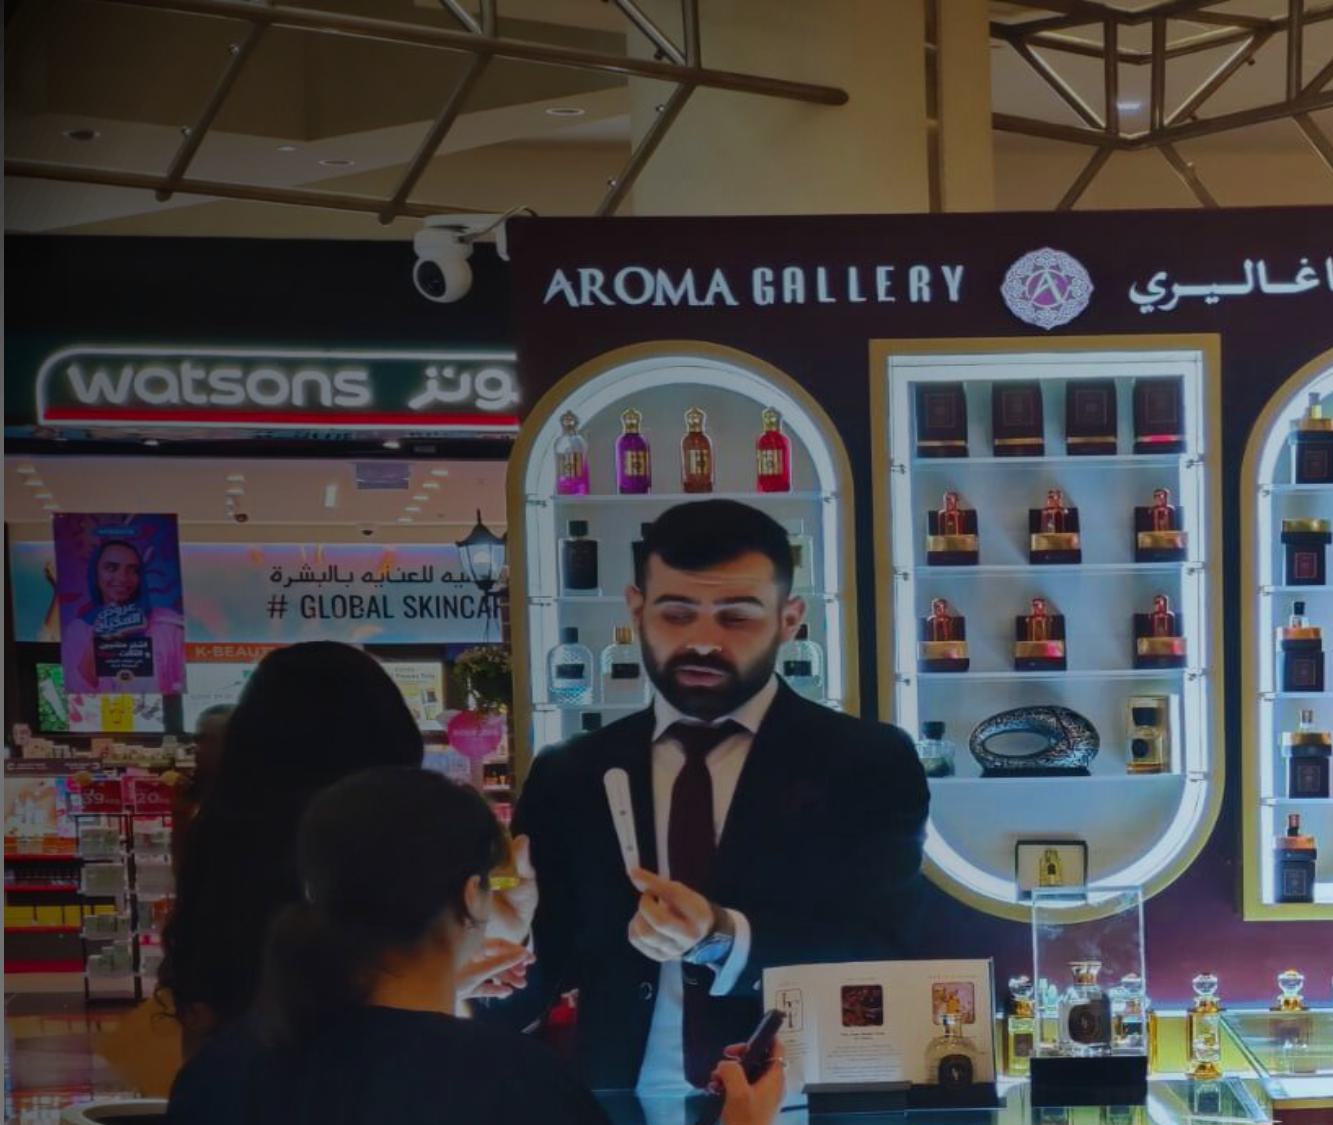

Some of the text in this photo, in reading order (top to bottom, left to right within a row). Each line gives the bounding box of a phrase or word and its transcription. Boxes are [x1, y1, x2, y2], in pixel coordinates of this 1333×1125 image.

[544, 265, 964, 307] AROMA GALLERY
[1127, 257, 1320, 313] غاليري
[67, 362, 370, 406] watsons
[269, 563, 354, 588] بالبشرة
[266, 594, 288, 619] #
[301, 594, 395, 619] GLOBAL
